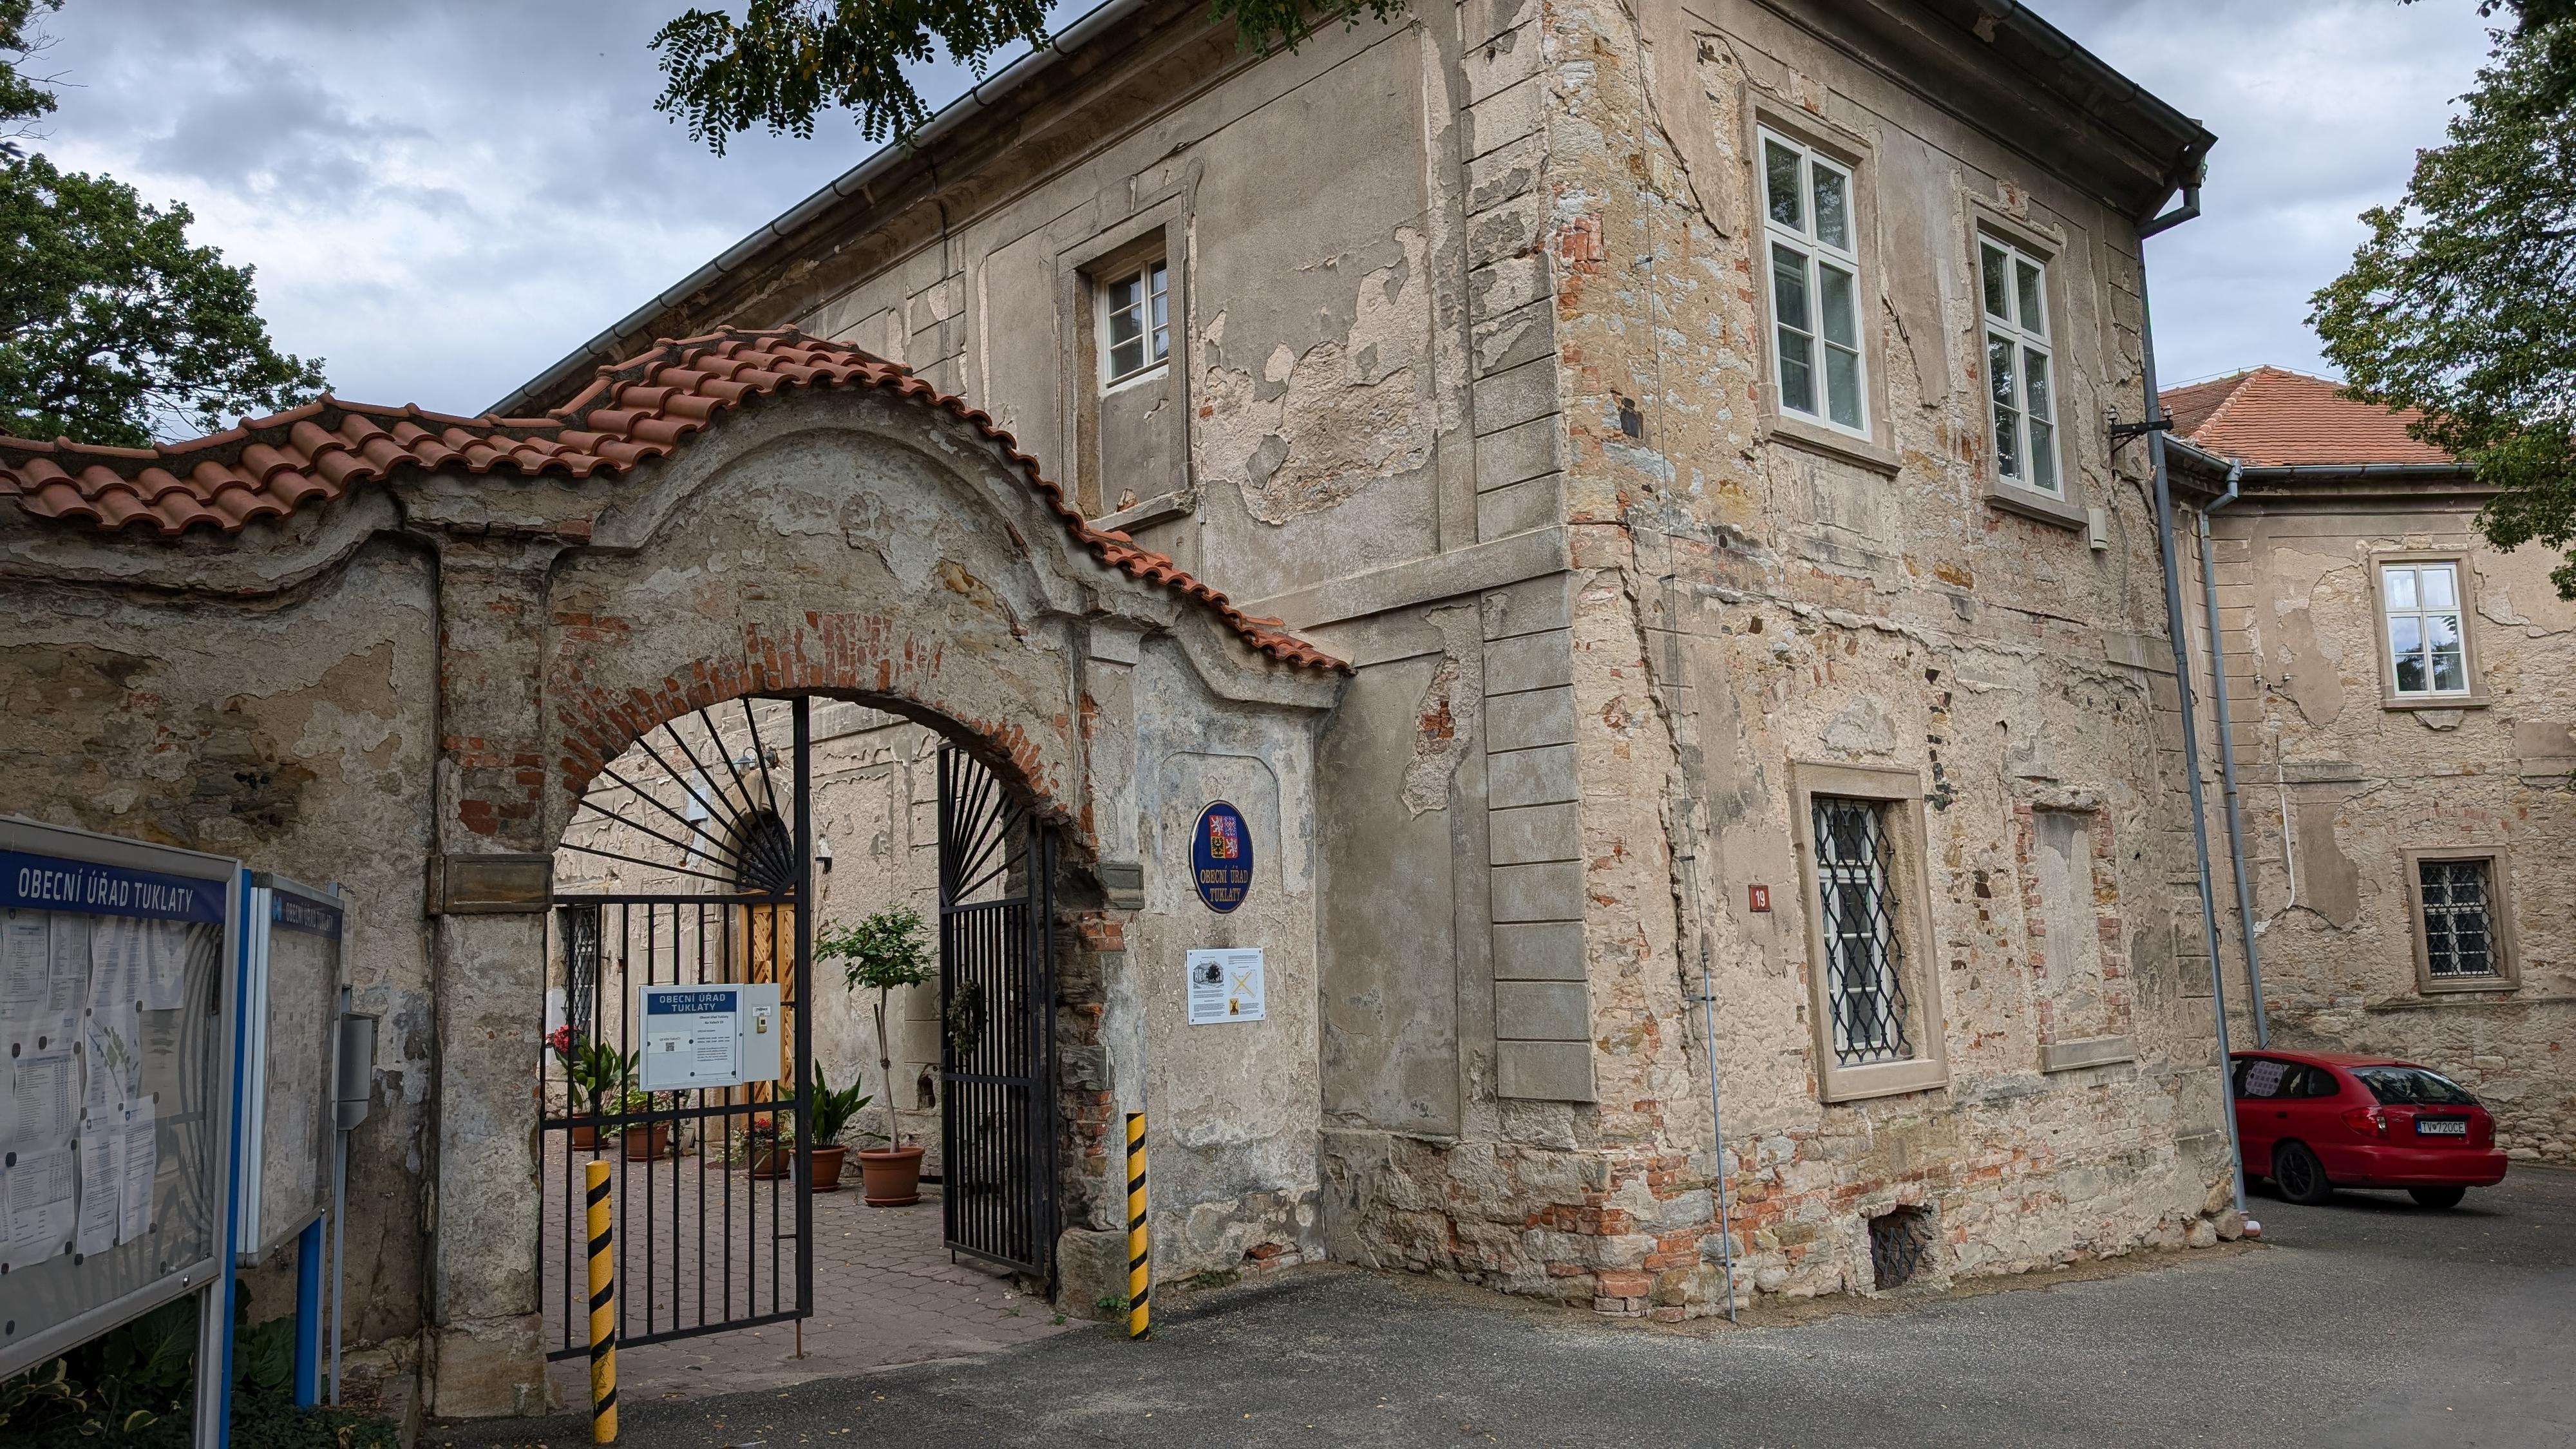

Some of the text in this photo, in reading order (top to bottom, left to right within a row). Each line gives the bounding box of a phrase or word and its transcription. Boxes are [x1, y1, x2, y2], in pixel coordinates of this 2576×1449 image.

[1200, 864, 1248, 884] OBECNÍ ÚŘAD
[18, 867, 193, 913] OBECNÍ ÚŘAD TUKLATY
[1209, 887, 1241, 902] TUKLATY
[1756, 890, 1765, 907] 19
[659, 992, 726, 1003] OBECNÍ ÚŘAD
[671, 1003, 716, 1012] TUKLATY
[2422, 1122, 2465, 1133] TV 720CE
